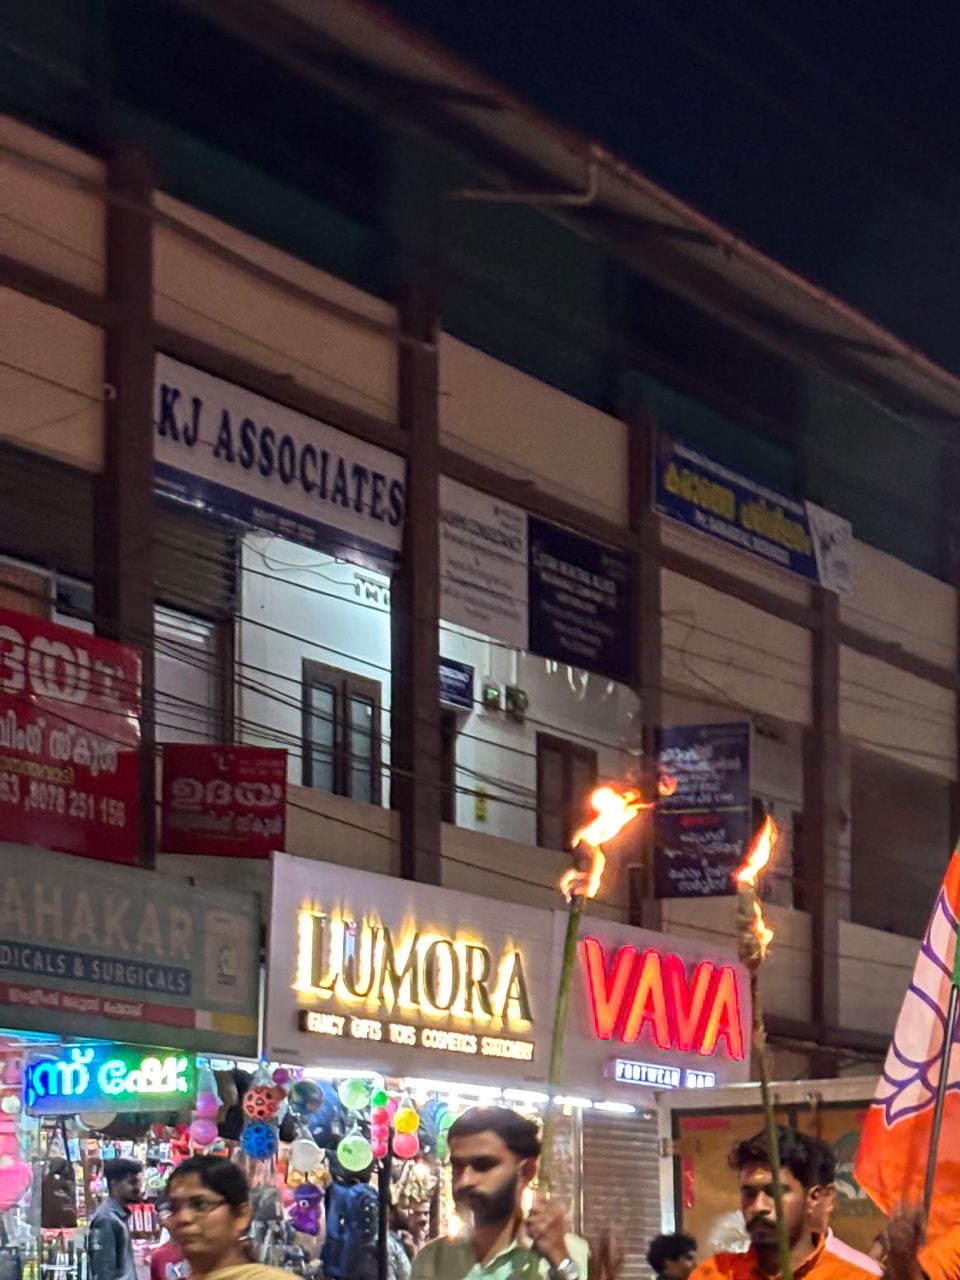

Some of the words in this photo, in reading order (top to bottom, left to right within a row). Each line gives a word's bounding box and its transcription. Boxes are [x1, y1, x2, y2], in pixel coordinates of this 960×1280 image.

[158, 383, 202, 448] KJ
[212, 408, 406, 527] ASSOCIATES
[73, 956, 85, 978] &
[91, 962, 188, 993] SURGICALS
[297, 908, 535, 1024] LUMORA
[585, 936, 745, 1063] VAVA
[307, 1010, 346, 1037] FANCY
[351, 1016, 383, 1042] GIFTS
[422, 1027, 478, 1055] COSMETICS
[616, 1060, 680, 1087] FOOTWEAR
